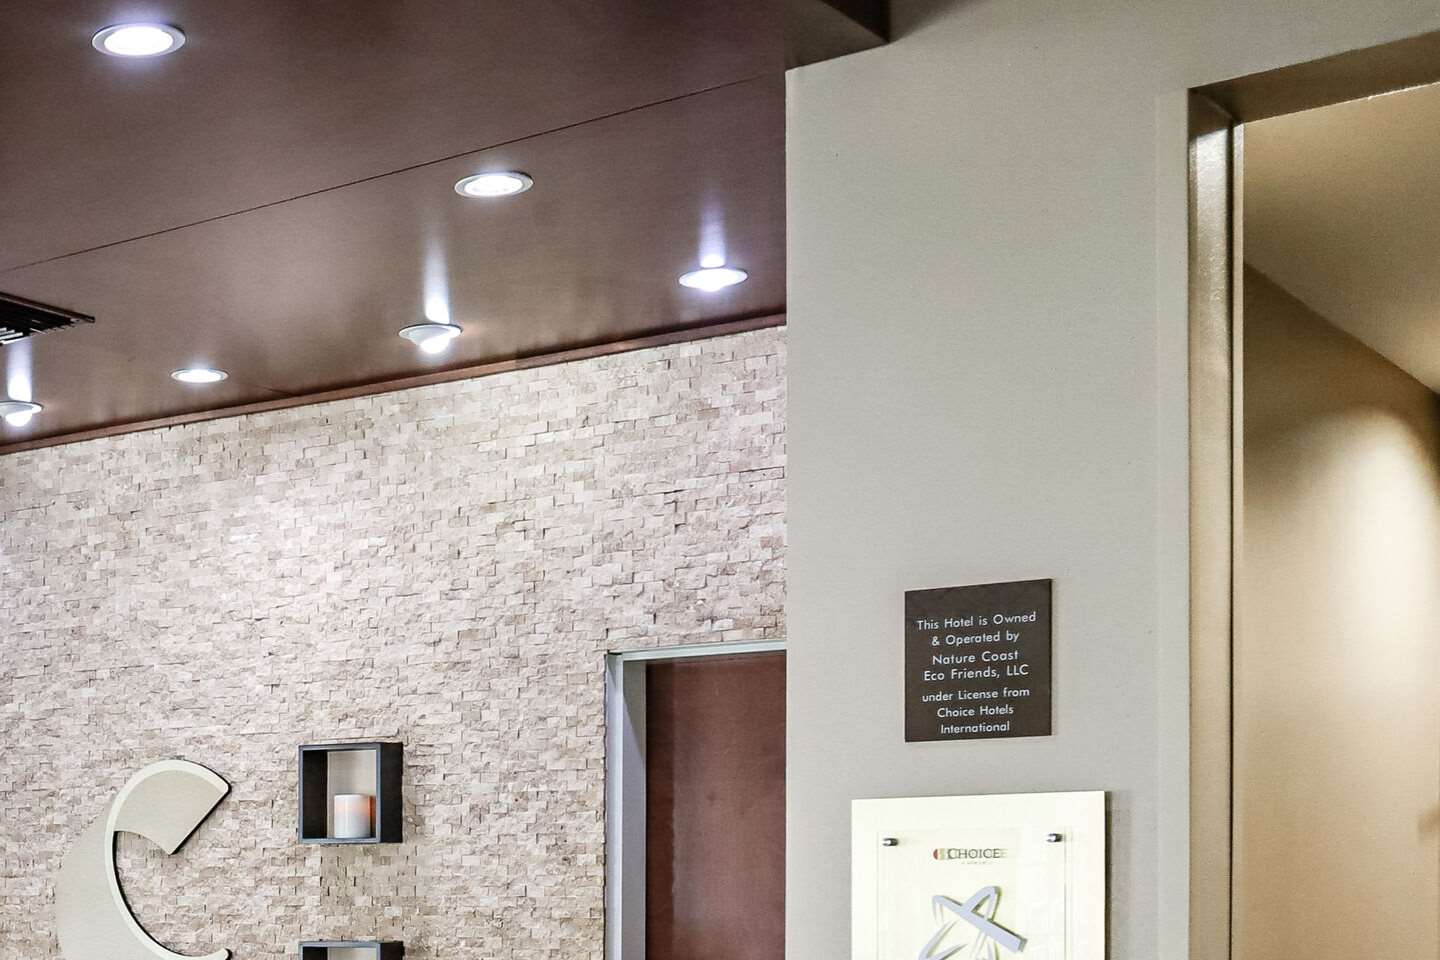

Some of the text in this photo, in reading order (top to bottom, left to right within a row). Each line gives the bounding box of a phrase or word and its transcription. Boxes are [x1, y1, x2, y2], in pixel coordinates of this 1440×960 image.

[916, 611, 1037, 630] This Hotel is Owned
[931, 630, 1020, 646] & Operated by
[932, 650, 1019, 665] Nature Coast
[924, 664, 1029, 681] Eco Friends, LLC
[922, 687, 1030, 702] under License from
[937, 704, 1015, 718] Choice Hotels
[941, 721, 1010, 734] International
[947, 848, 1002, 860] CHOICE
